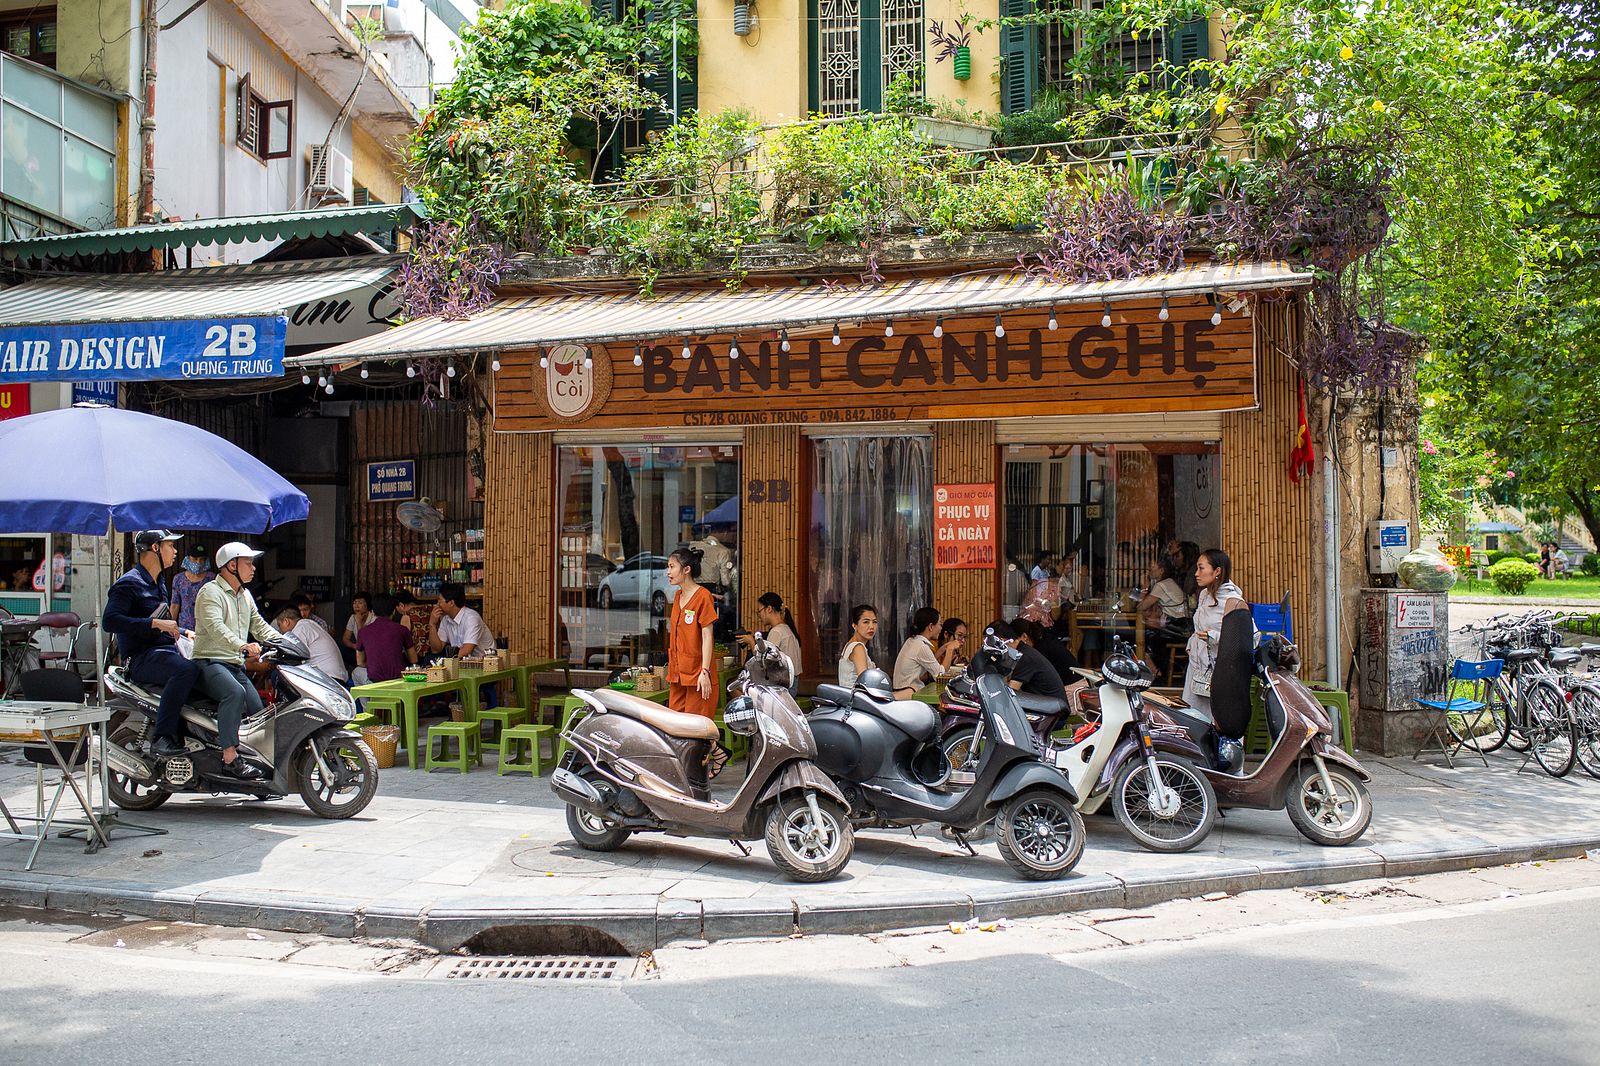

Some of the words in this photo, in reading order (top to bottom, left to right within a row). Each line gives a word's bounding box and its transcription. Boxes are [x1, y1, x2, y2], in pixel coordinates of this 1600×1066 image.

[202, 324, 257, 357] 2B
[0, 340, 51, 373] AIR
[57, 335, 166, 371] DESIGN
[846, 328, 1043, 389] CANH
[1067, 319, 1217, 389] GHẸ
[181, 361, 229, 378] QUANG
[232, 358, 273, 375] TRUNG
[556, 379, 583, 397] Còi
[727, 410, 768, 426] QUANG
[770, 409, 809, 424] TRUNG
[819, 407, 897, 423] 094.842.1886
[748, 479, 790, 503] 2B
[938, 505, 971, 522] PHỤC
[973, 504, 990, 521] VỤ
[938, 523, 955, 541] CẢ
[957, 524, 991, 541] NGÀY
[937, 545, 959, 565] 8h00
[966, 545, 993, 565] 21h30
[303, 712, 325, 723] HONDA
